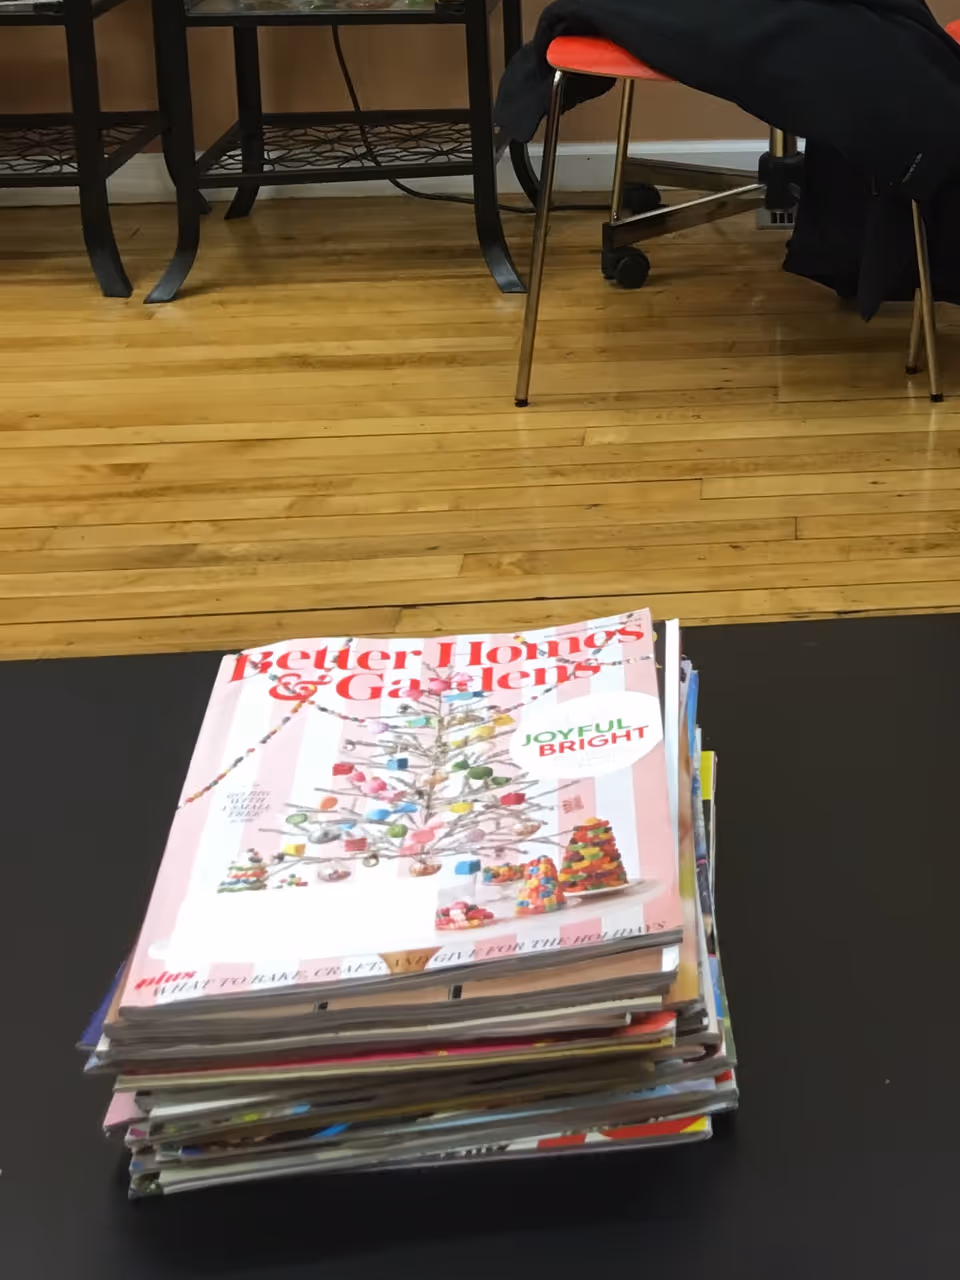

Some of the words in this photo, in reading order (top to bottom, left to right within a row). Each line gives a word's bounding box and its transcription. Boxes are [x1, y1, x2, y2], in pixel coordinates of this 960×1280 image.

[228, 645, 423, 683] Better
[437, 623, 645, 668] Homes
[268, 673, 333, 702] &
[336, 657, 601, 701] Gadens
[521, 718, 632, 746] JOYFUL
[539, 725, 650, 757] BRIGHT
[152, 978, 217, 998] WHAT
[219, 976, 248, 988] TO
[433, 941, 480, 963] GIVE
[485, 941, 526, 958] FOR
[529, 935, 571, 950] THE
[573, 920, 668, 946] HOLIDAYS
[134, 970, 198, 991] plus
